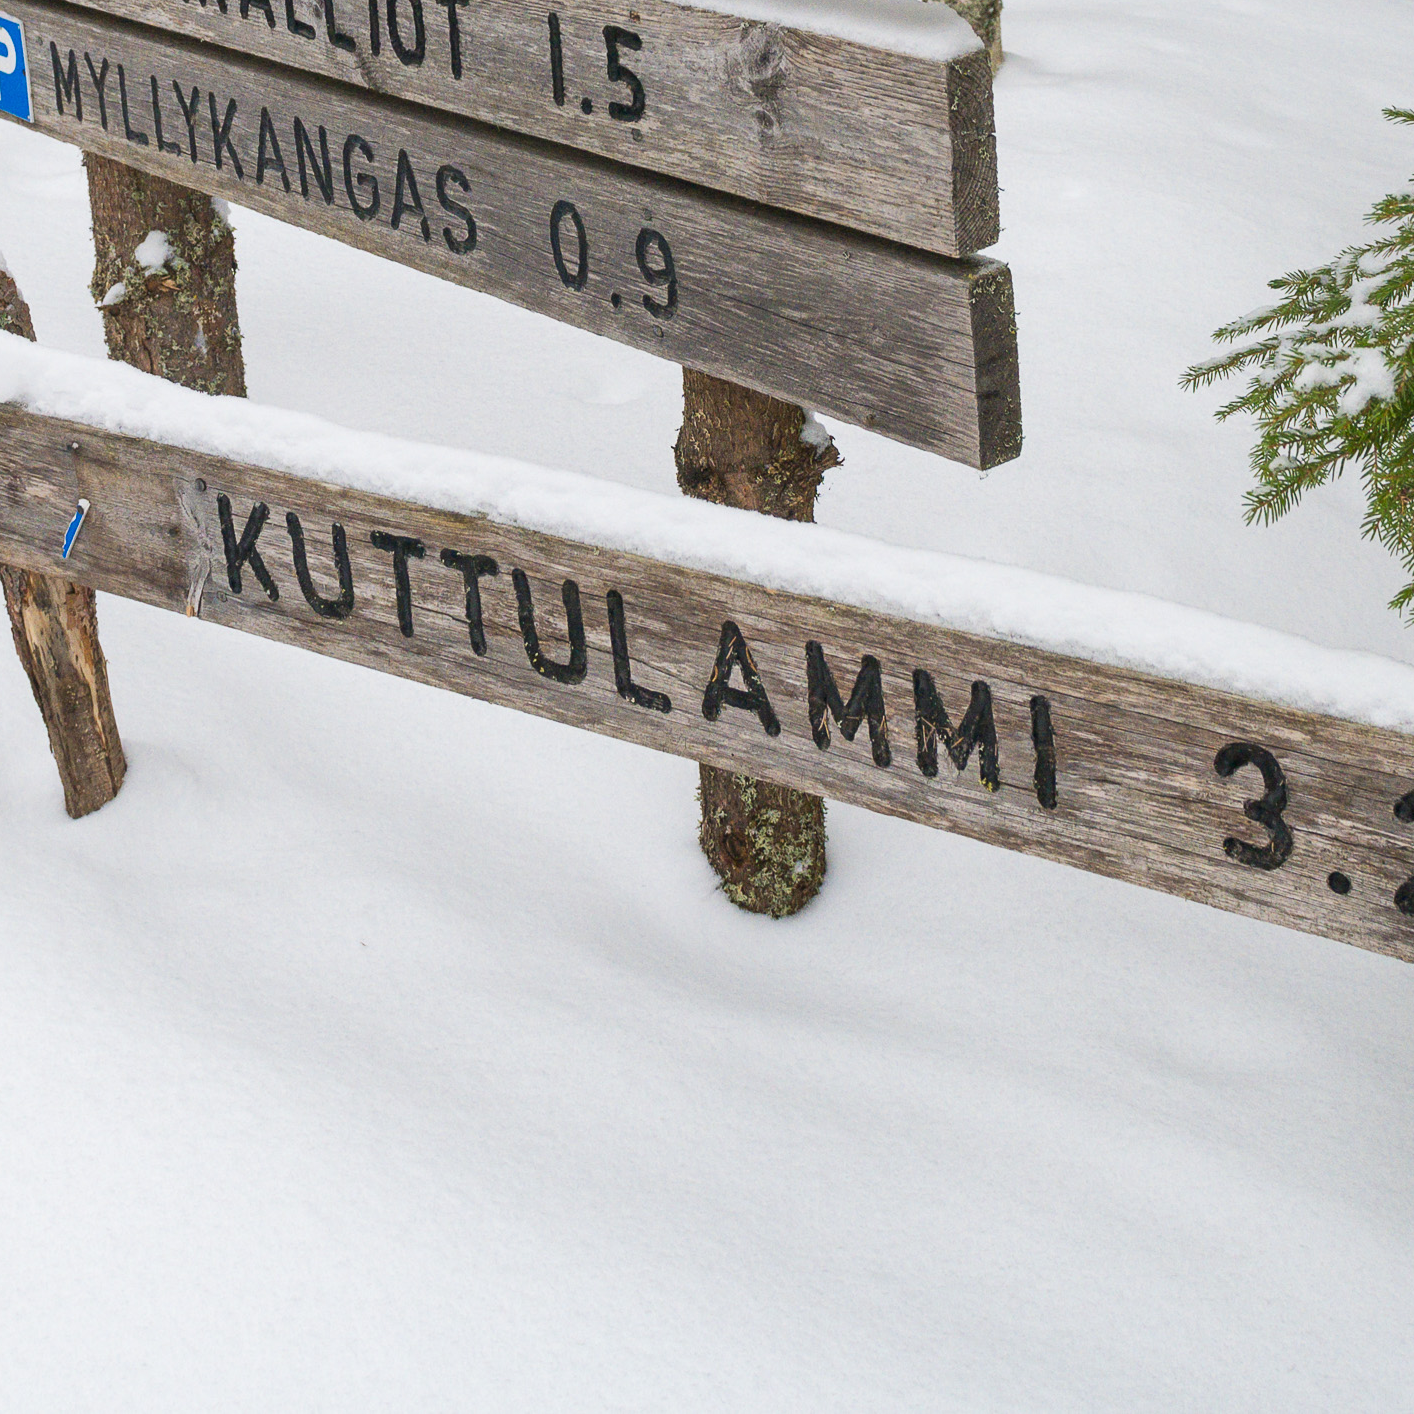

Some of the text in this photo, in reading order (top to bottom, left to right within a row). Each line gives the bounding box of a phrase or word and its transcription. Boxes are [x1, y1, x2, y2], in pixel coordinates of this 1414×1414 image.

[49, 40, 679, 319] MYLLYKANGAS 0.9
[547, 12, 647, 122] 1.5
[216, 492, 1058, 809] KUTTULAMMI
